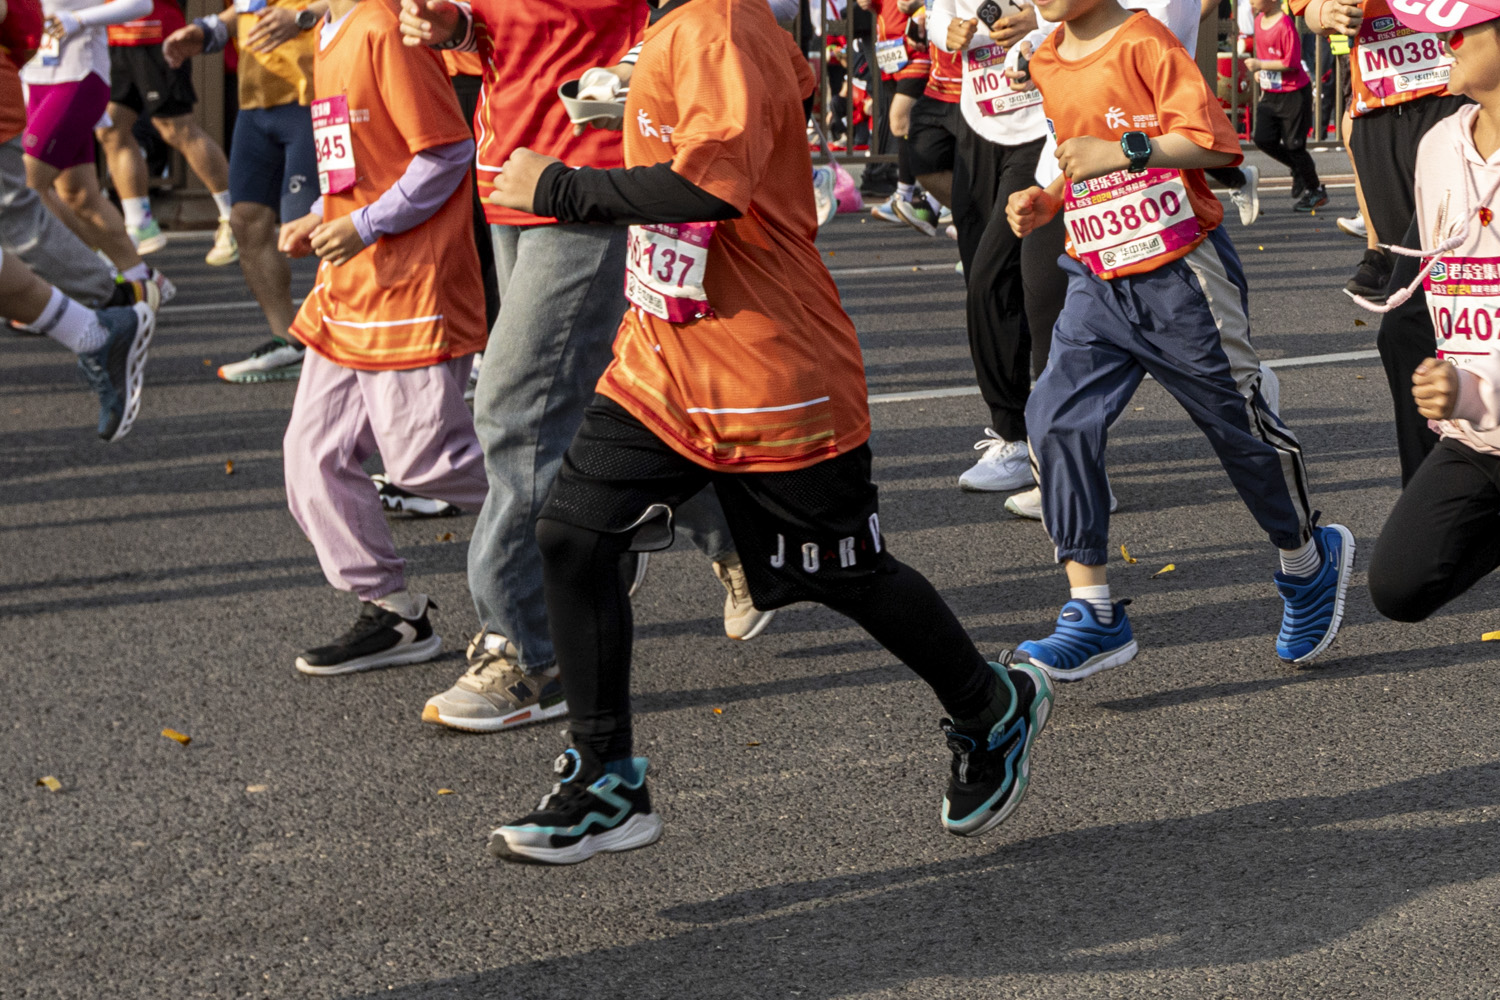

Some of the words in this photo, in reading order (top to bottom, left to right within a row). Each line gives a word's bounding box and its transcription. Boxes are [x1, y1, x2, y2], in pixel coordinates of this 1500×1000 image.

[1070, 190, 1181, 245] M03800
[1120, 237, 1160, 257] 华中集团
